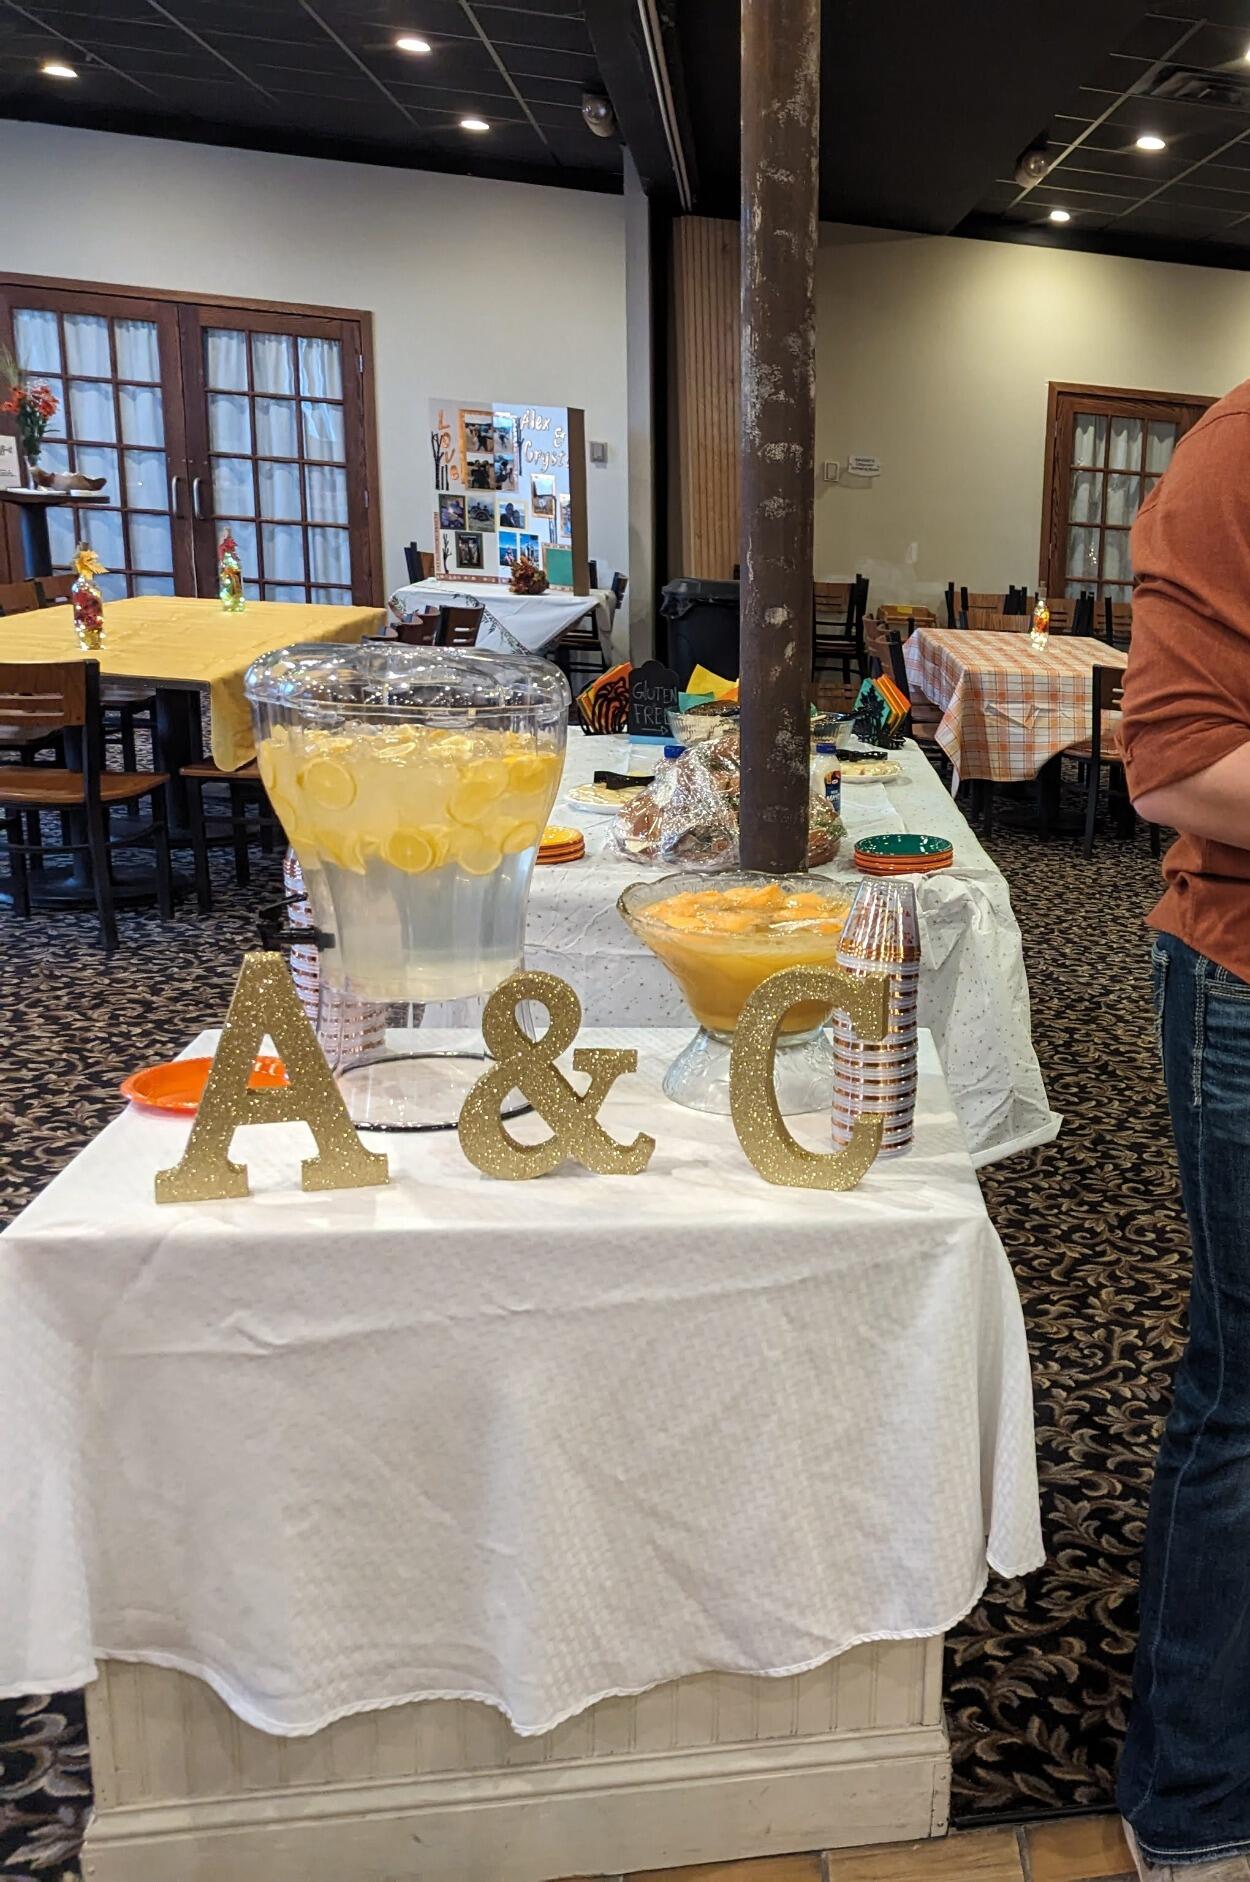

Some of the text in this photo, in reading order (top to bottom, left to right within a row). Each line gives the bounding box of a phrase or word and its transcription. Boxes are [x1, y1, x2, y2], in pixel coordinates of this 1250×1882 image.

[520, 409, 551, 431] Alex
[525, 440, 570, 473] Cryst
[155, 951, 889, 1205] A & C
